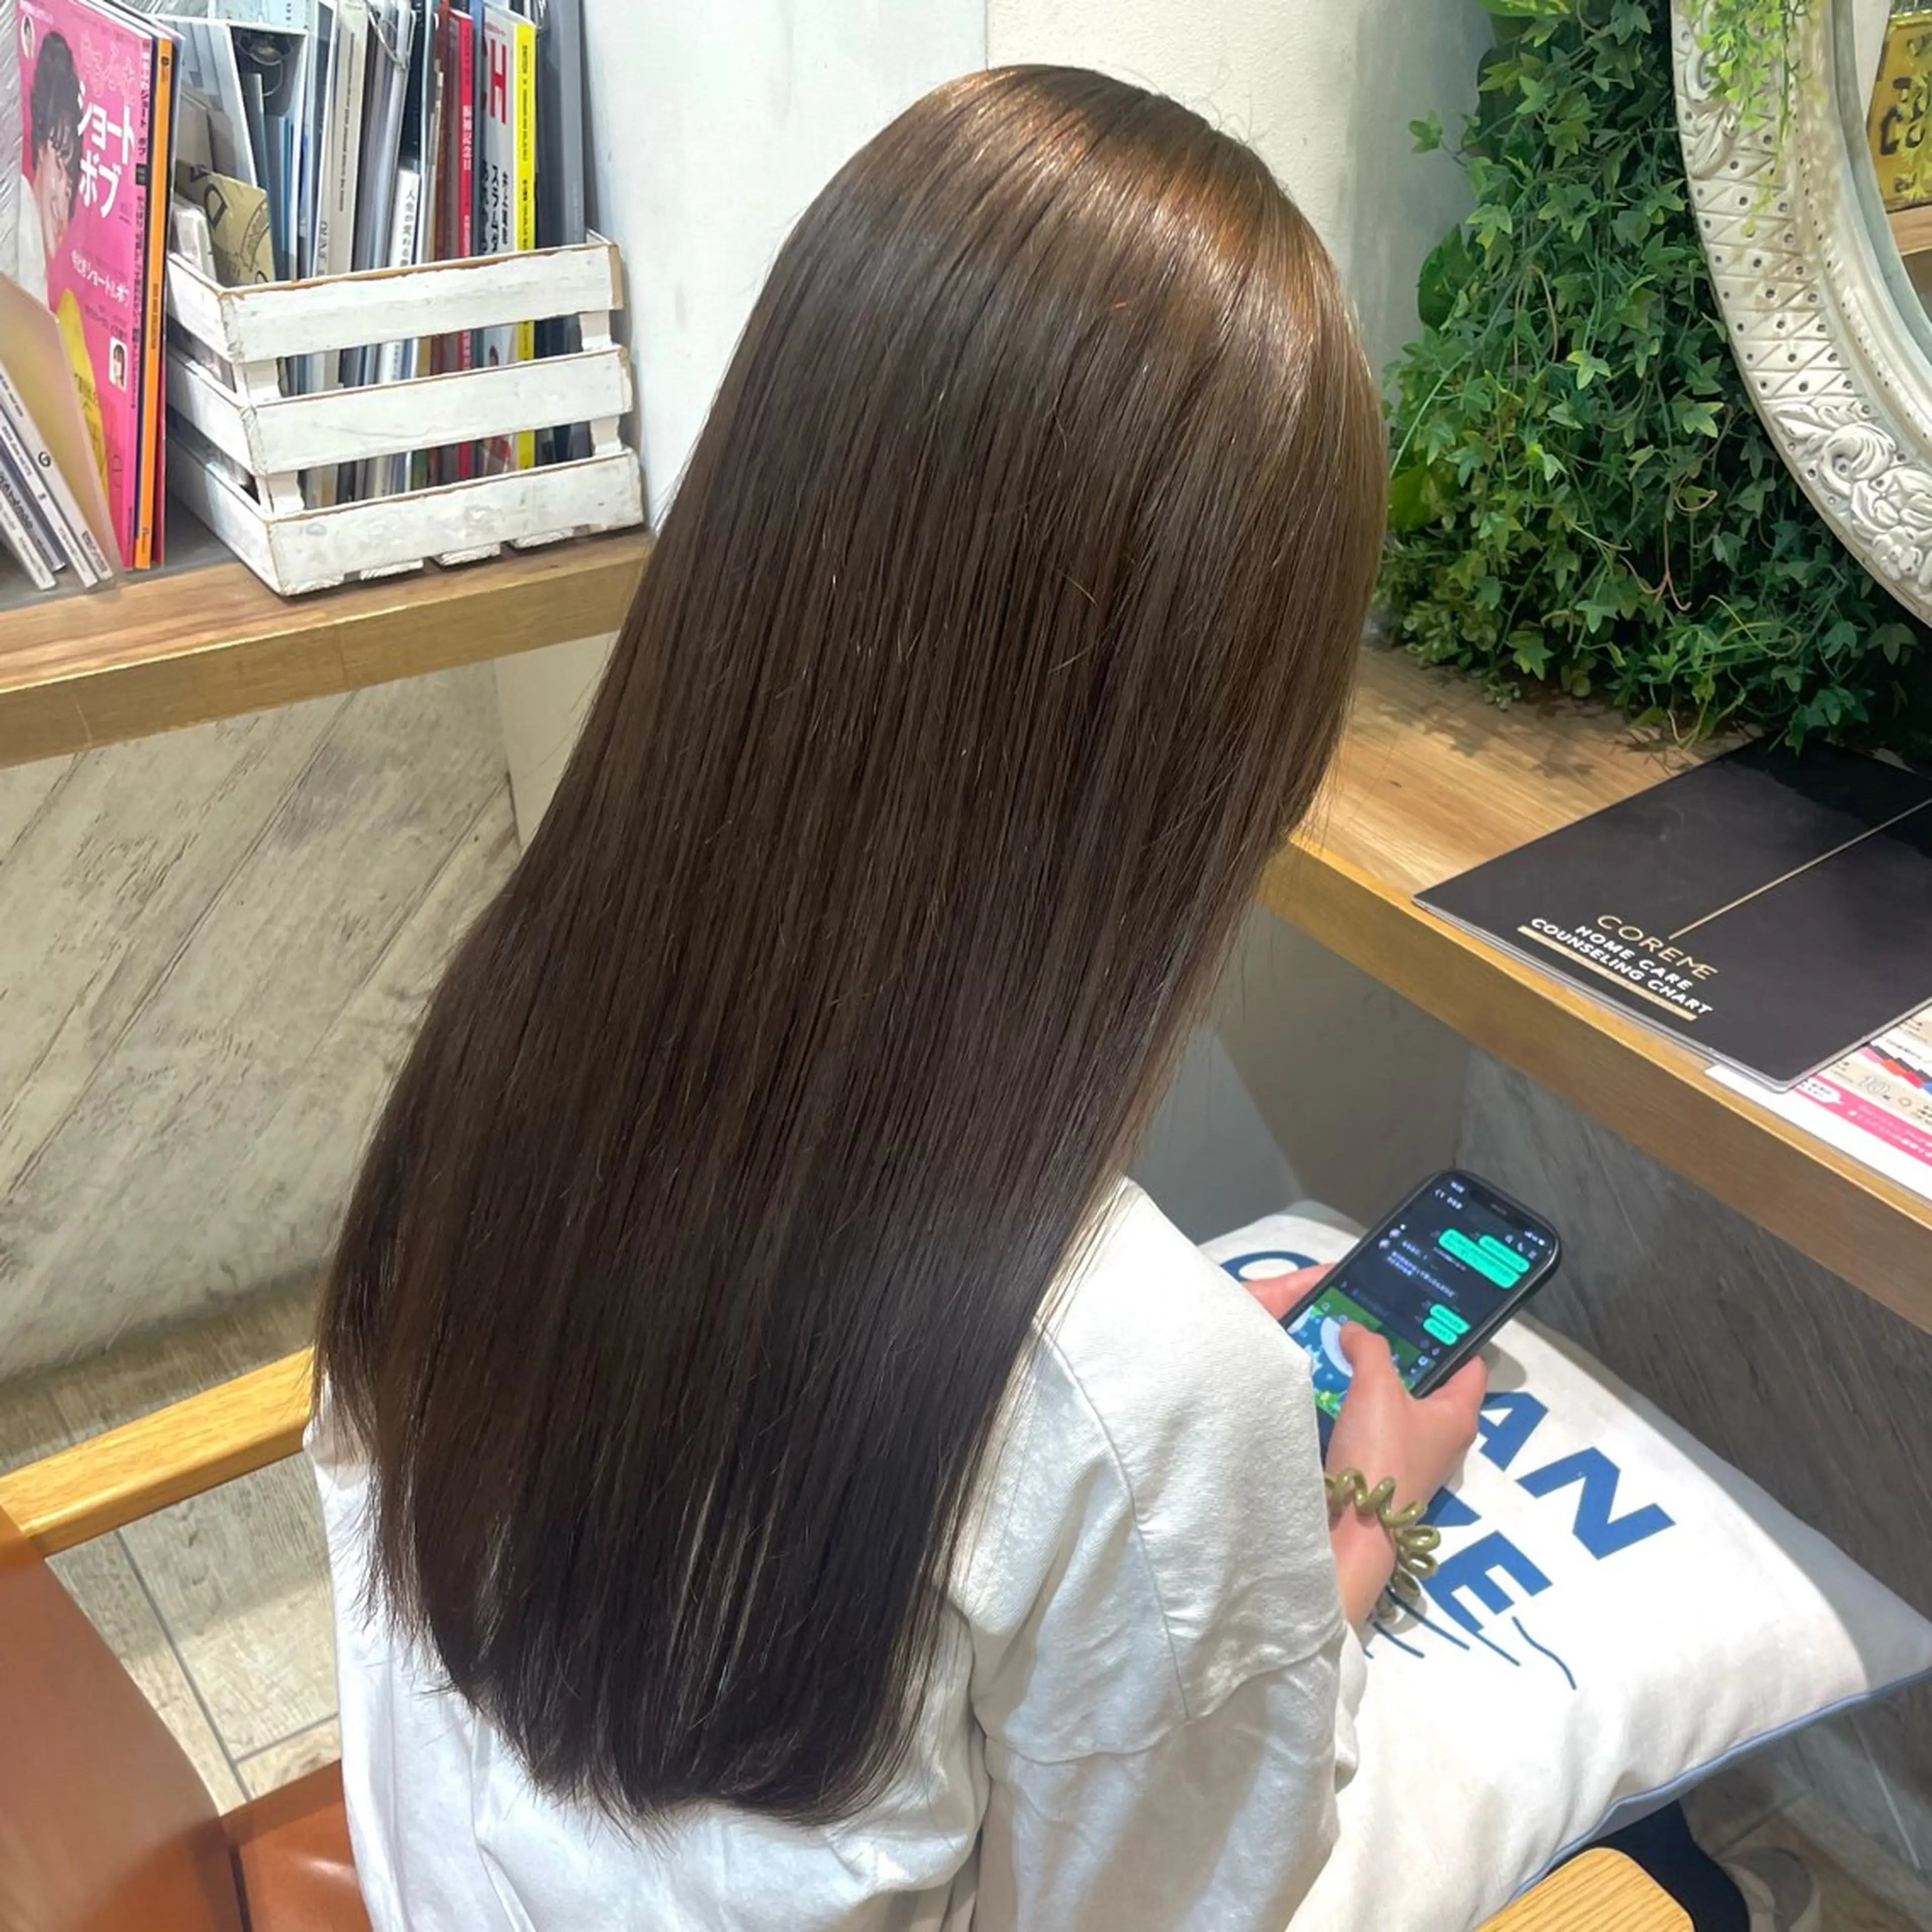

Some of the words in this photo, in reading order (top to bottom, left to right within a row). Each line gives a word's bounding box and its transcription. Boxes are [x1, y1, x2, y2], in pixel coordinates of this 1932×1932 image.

[77, 80, 136, 165] ショート
[79, 149, 122, 218] ボブ
[1531, 918, 1645, 981] COUNSELING
[1647, 980, 1713, 1014] CHART
[1575, 925, 1635, 959] HOME
[1639, 959, 1694, 990] CARE
[1597, 915, 1718, 980] COREME
